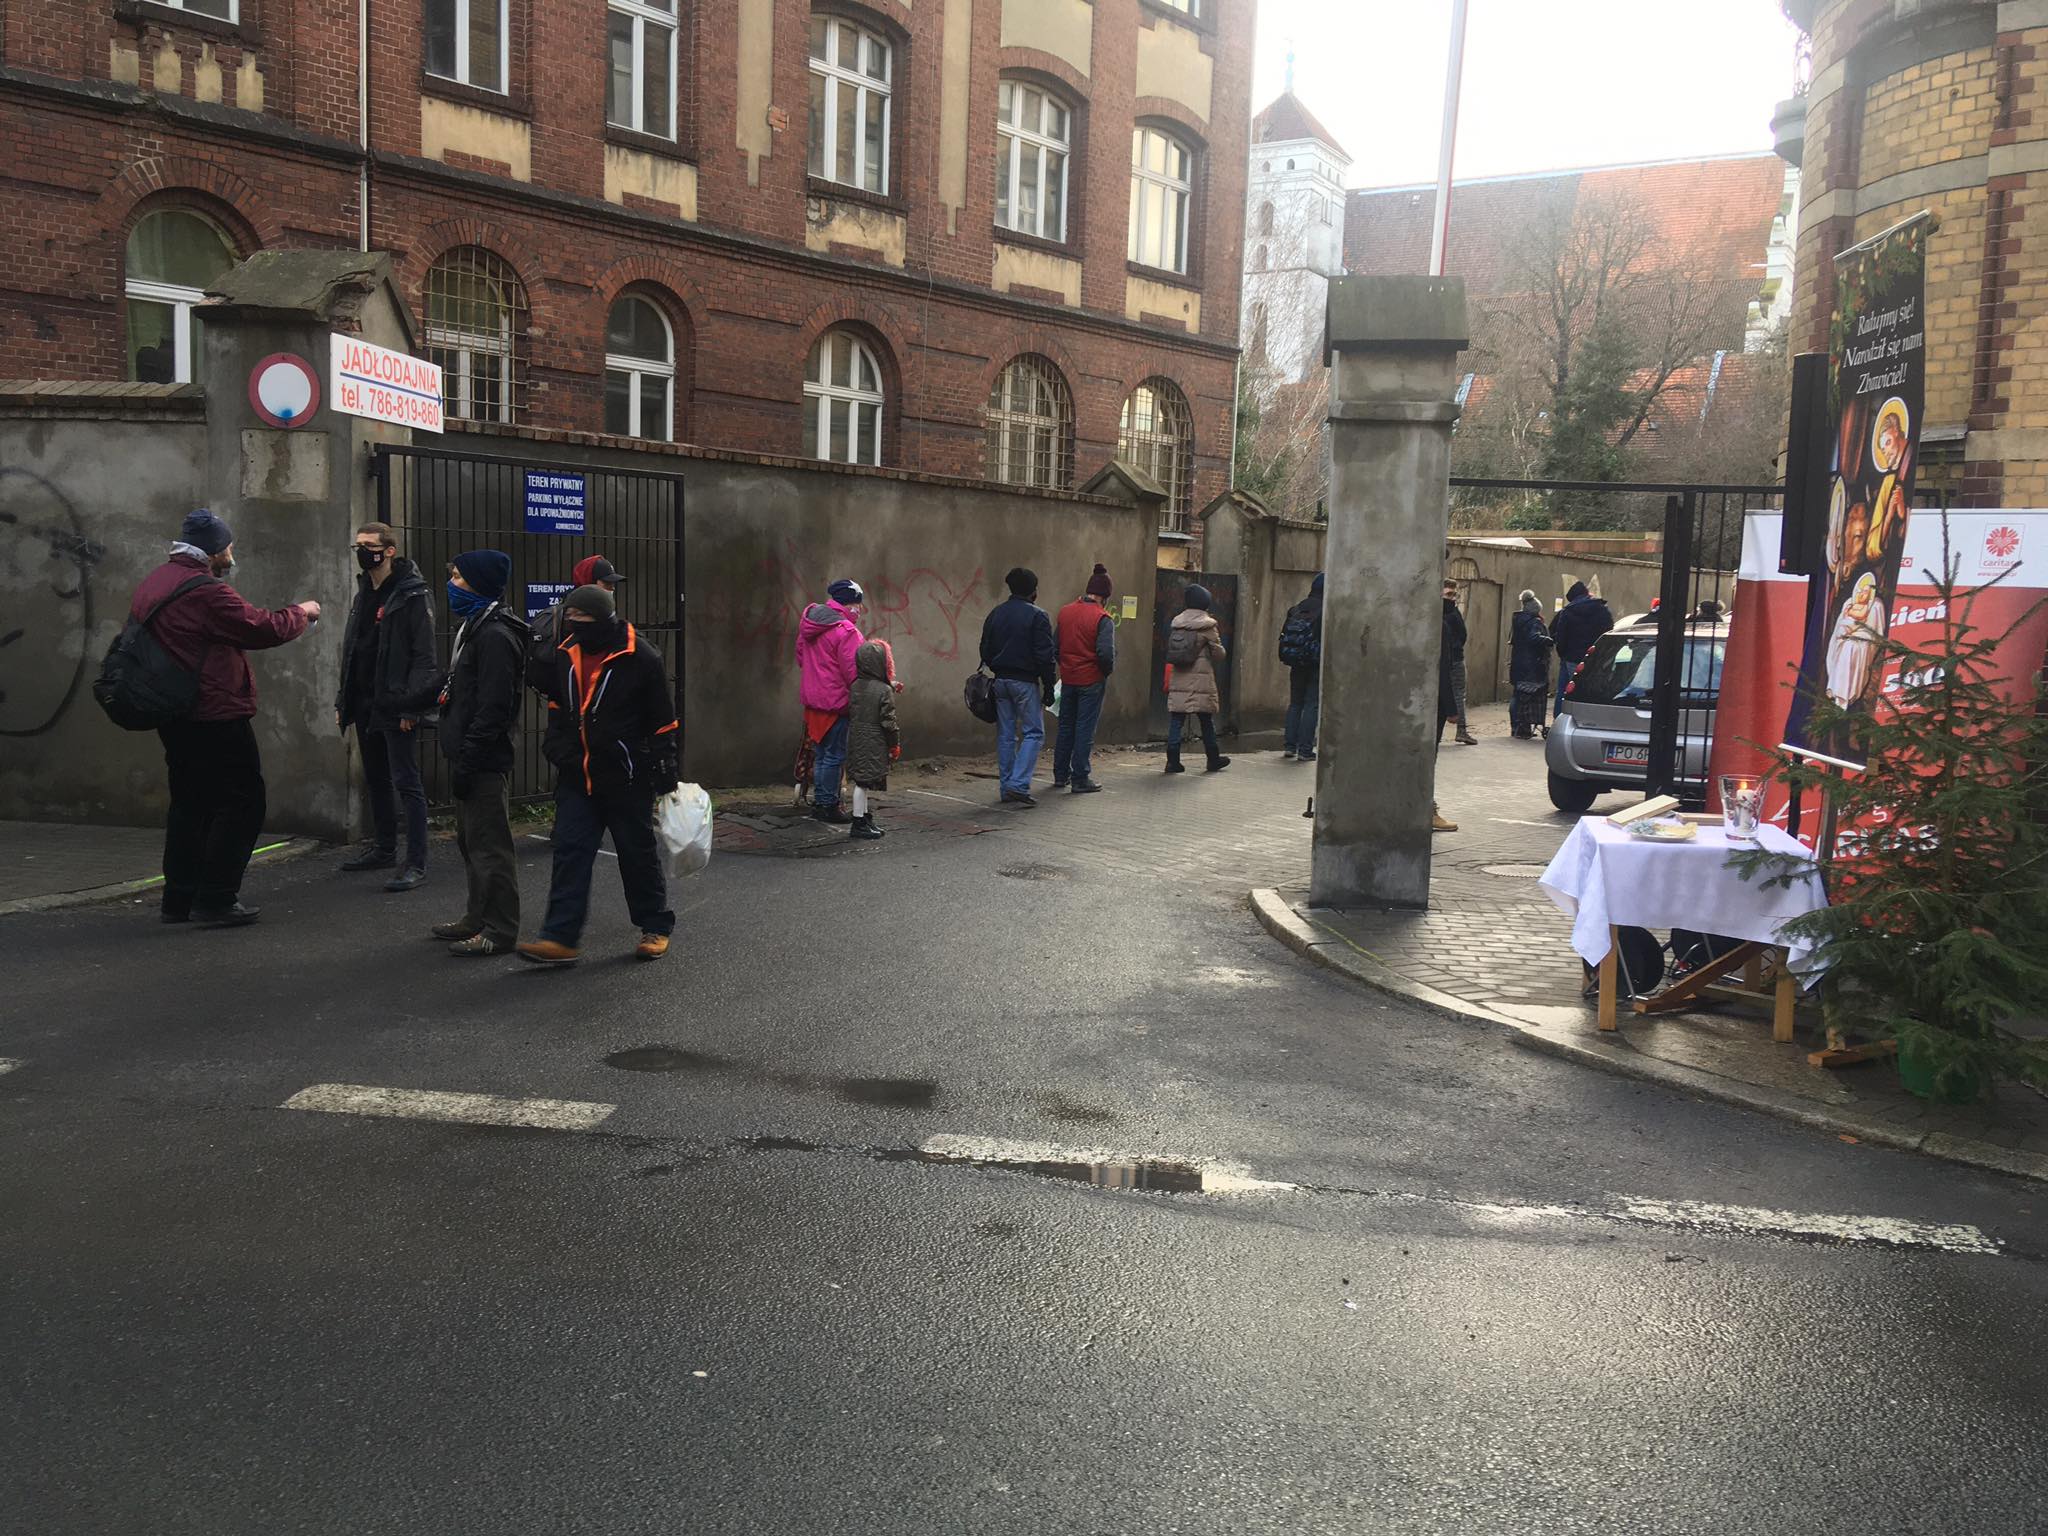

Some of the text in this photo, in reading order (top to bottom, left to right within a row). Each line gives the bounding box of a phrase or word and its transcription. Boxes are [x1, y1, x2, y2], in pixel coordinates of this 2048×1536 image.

[1857, 296, 1915, 337] Radujmy się!
[1842, 331, 1923, 368] Narodził się nam
[341, 343, 438, 393] JADŁODAJNIA
[1856, 361, 1909, 395] Zbawiciel!
[341, 383, 439, 426] tel. 786-819-860
[527, 475, 584, 492] TEREN PRYWATNY
[528, 493, 552, 504] PARKING
[527, 507, 540, 517] DLA
[527, 585, 554, 593] TEREN
[1615, 746, 1633, 759] PO
